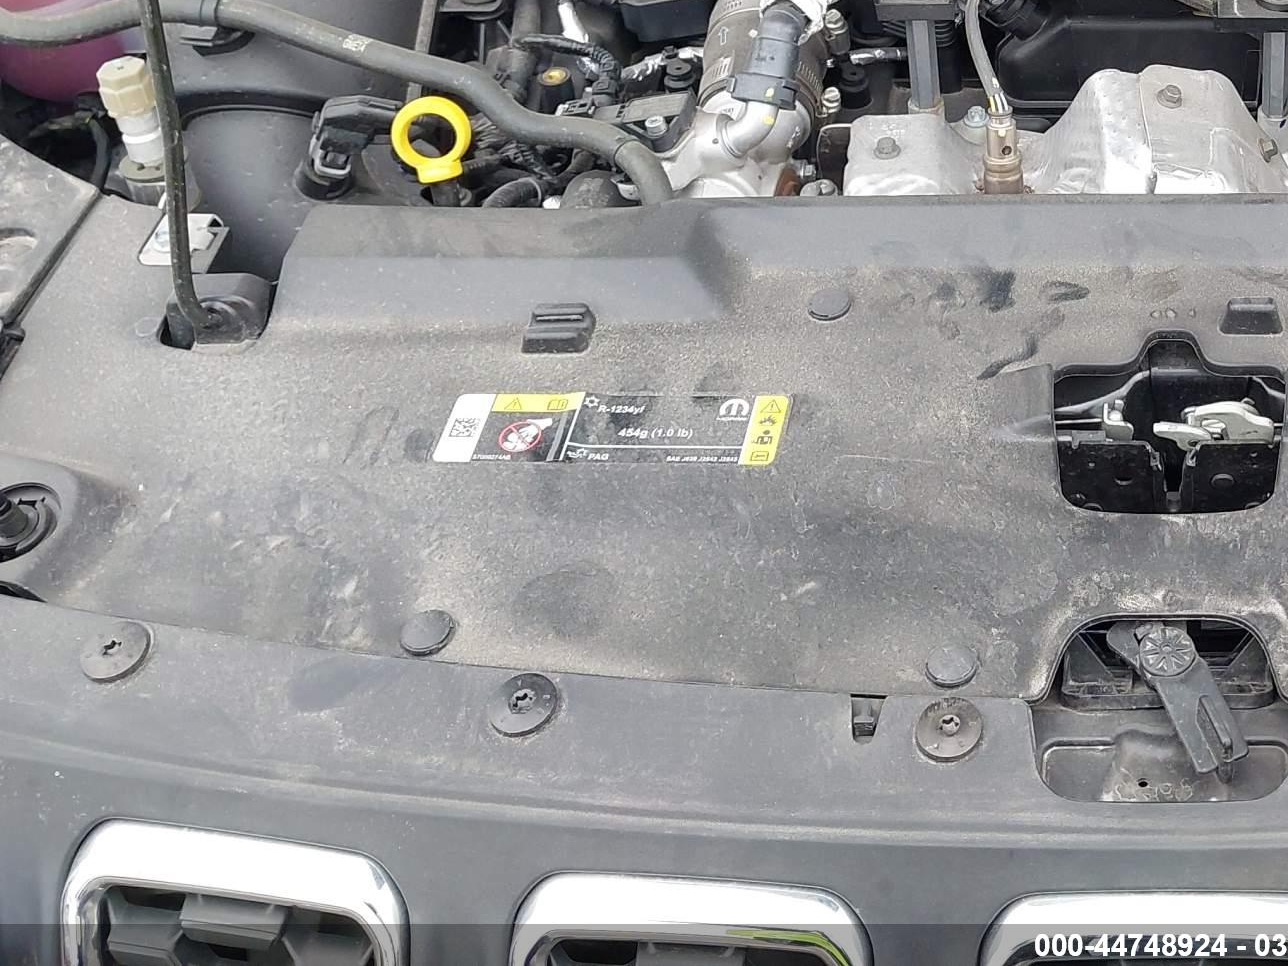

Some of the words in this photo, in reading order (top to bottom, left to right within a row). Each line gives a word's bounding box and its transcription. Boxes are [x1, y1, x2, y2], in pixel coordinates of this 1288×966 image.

[597, 405, 645, 414] R-1234yf
[617, 428, 649, 439] 454g
[651, 428, 674, 438] (1.0
[677, 428, 693, 439] lb)
